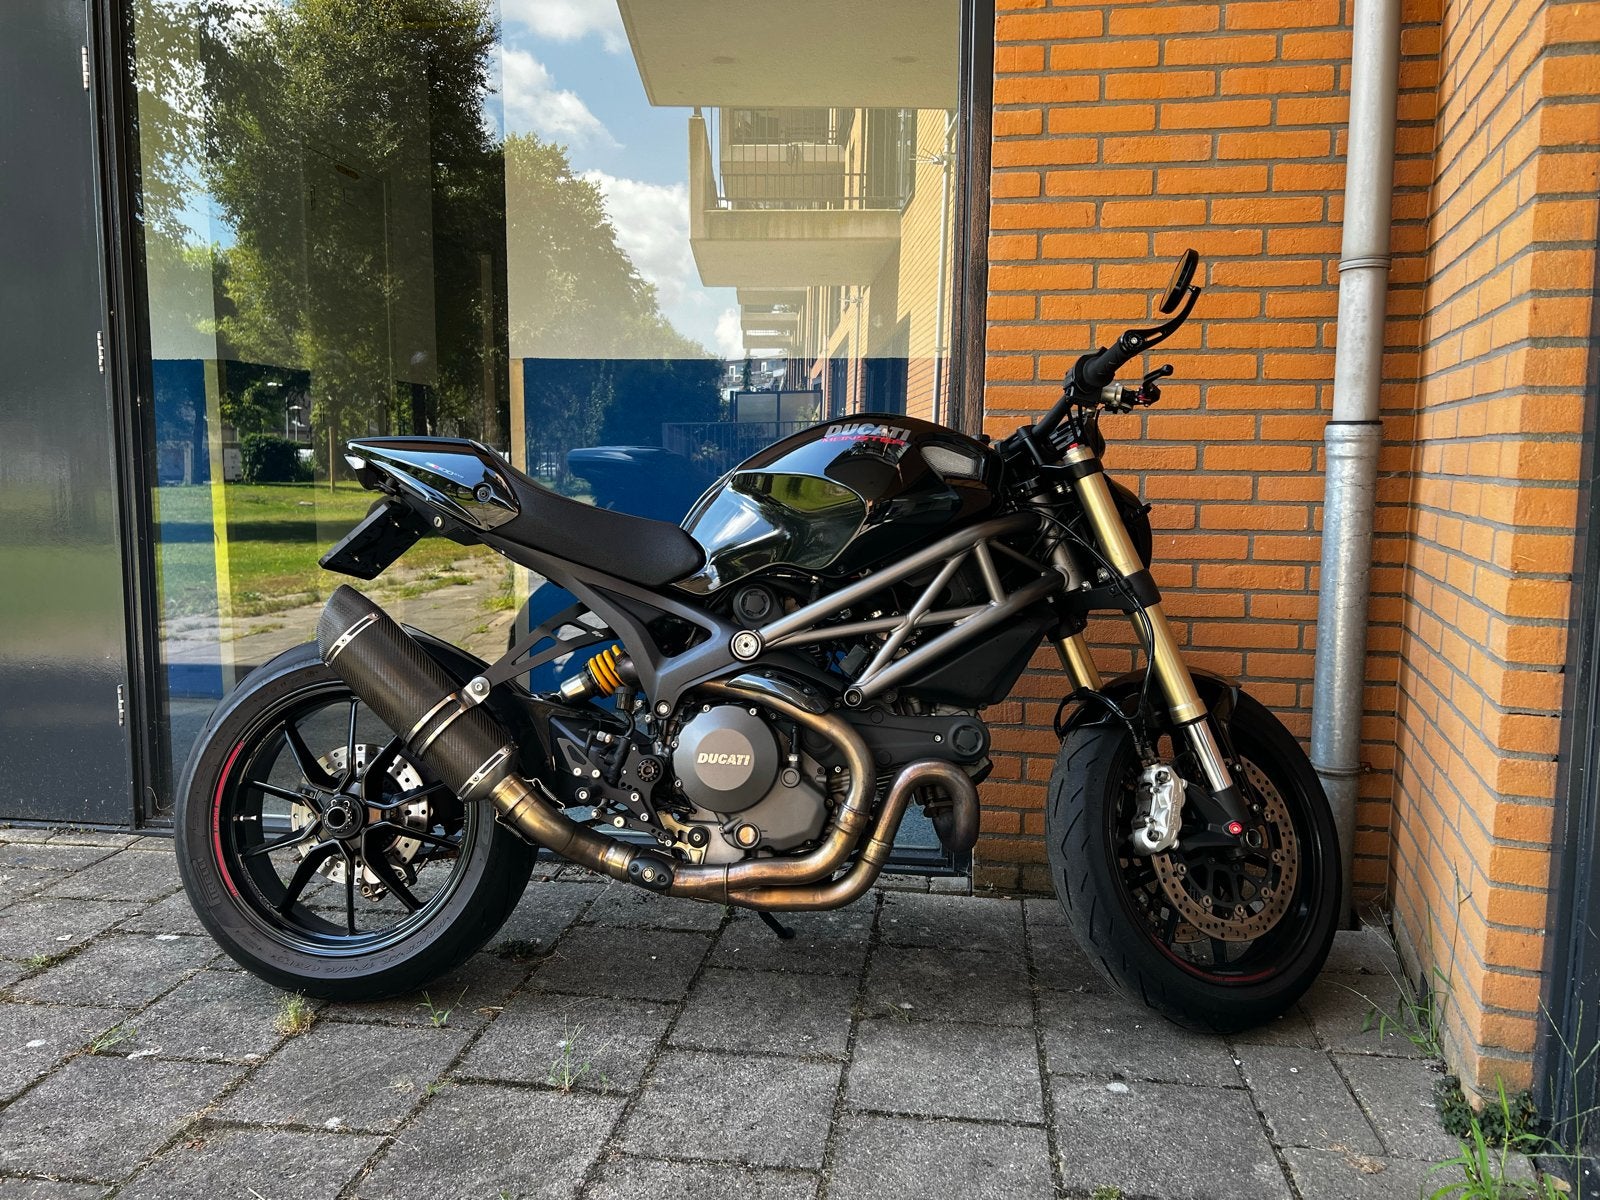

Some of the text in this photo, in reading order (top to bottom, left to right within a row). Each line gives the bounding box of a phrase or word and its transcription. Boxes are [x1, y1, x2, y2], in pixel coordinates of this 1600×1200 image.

[821, 435, 906, 445] MONSTER
[825, 423, 912, 441] DUCATI
[697, 752, 751, 766] DUCATI
[191, 857, 221, 908] PIRELLI
